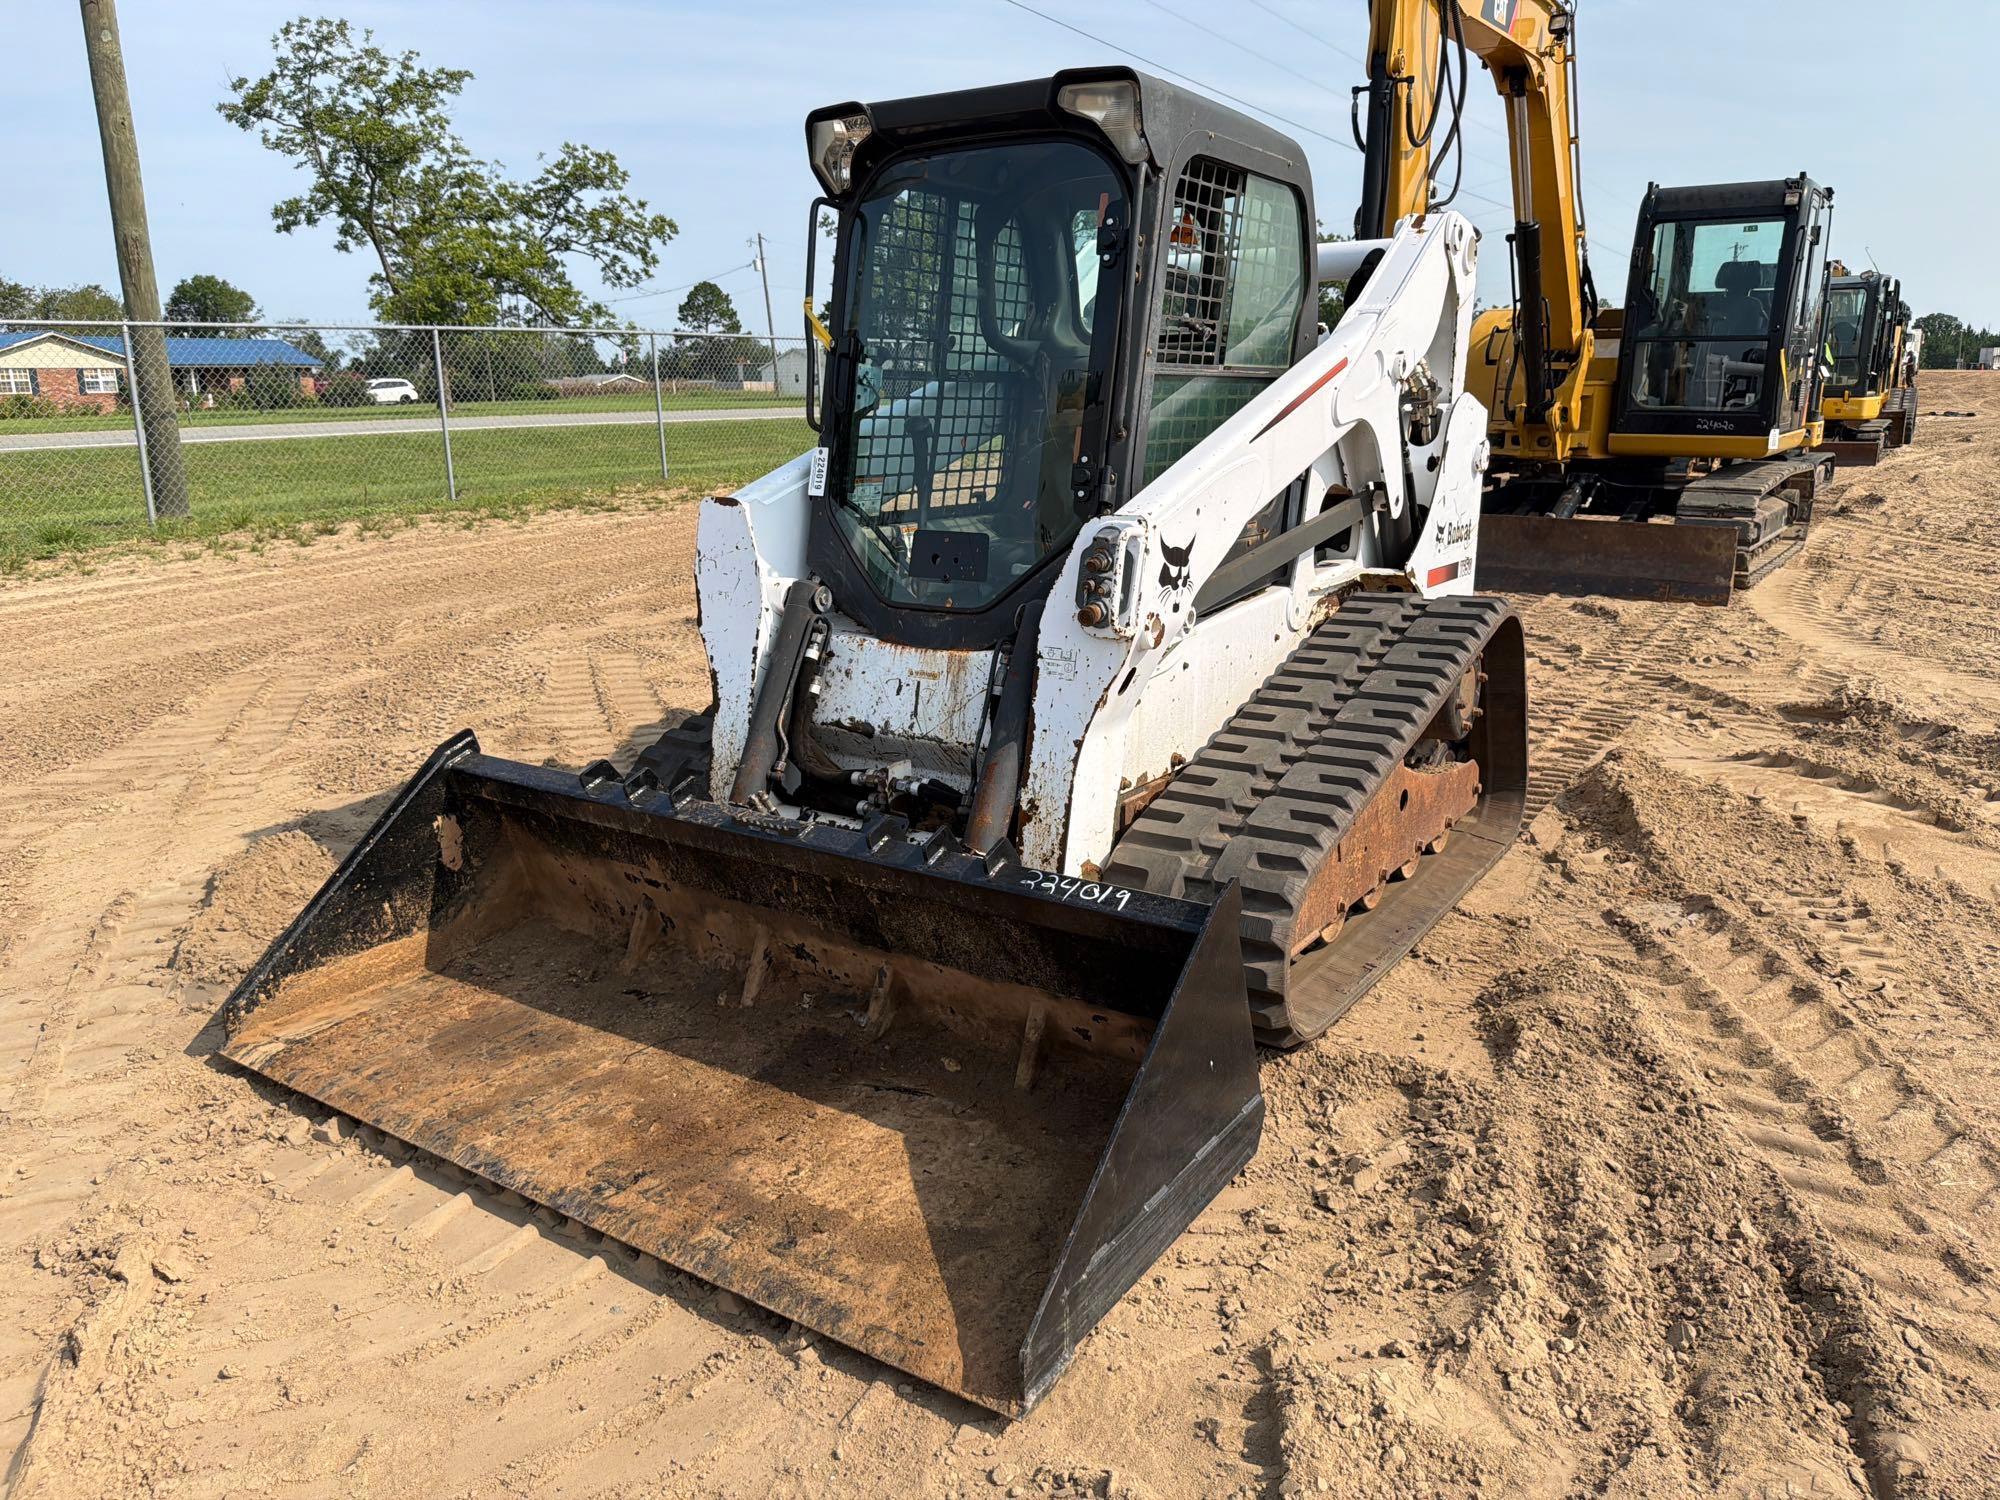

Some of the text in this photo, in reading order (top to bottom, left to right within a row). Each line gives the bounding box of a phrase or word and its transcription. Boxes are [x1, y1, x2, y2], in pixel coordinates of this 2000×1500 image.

[1696, 418, 1735, 430] 224020
[814, 457, 826, 490] 224019
[1447, 518, 1472, 545] Bobcat
[1020, 870, 1131, 911] 224019
